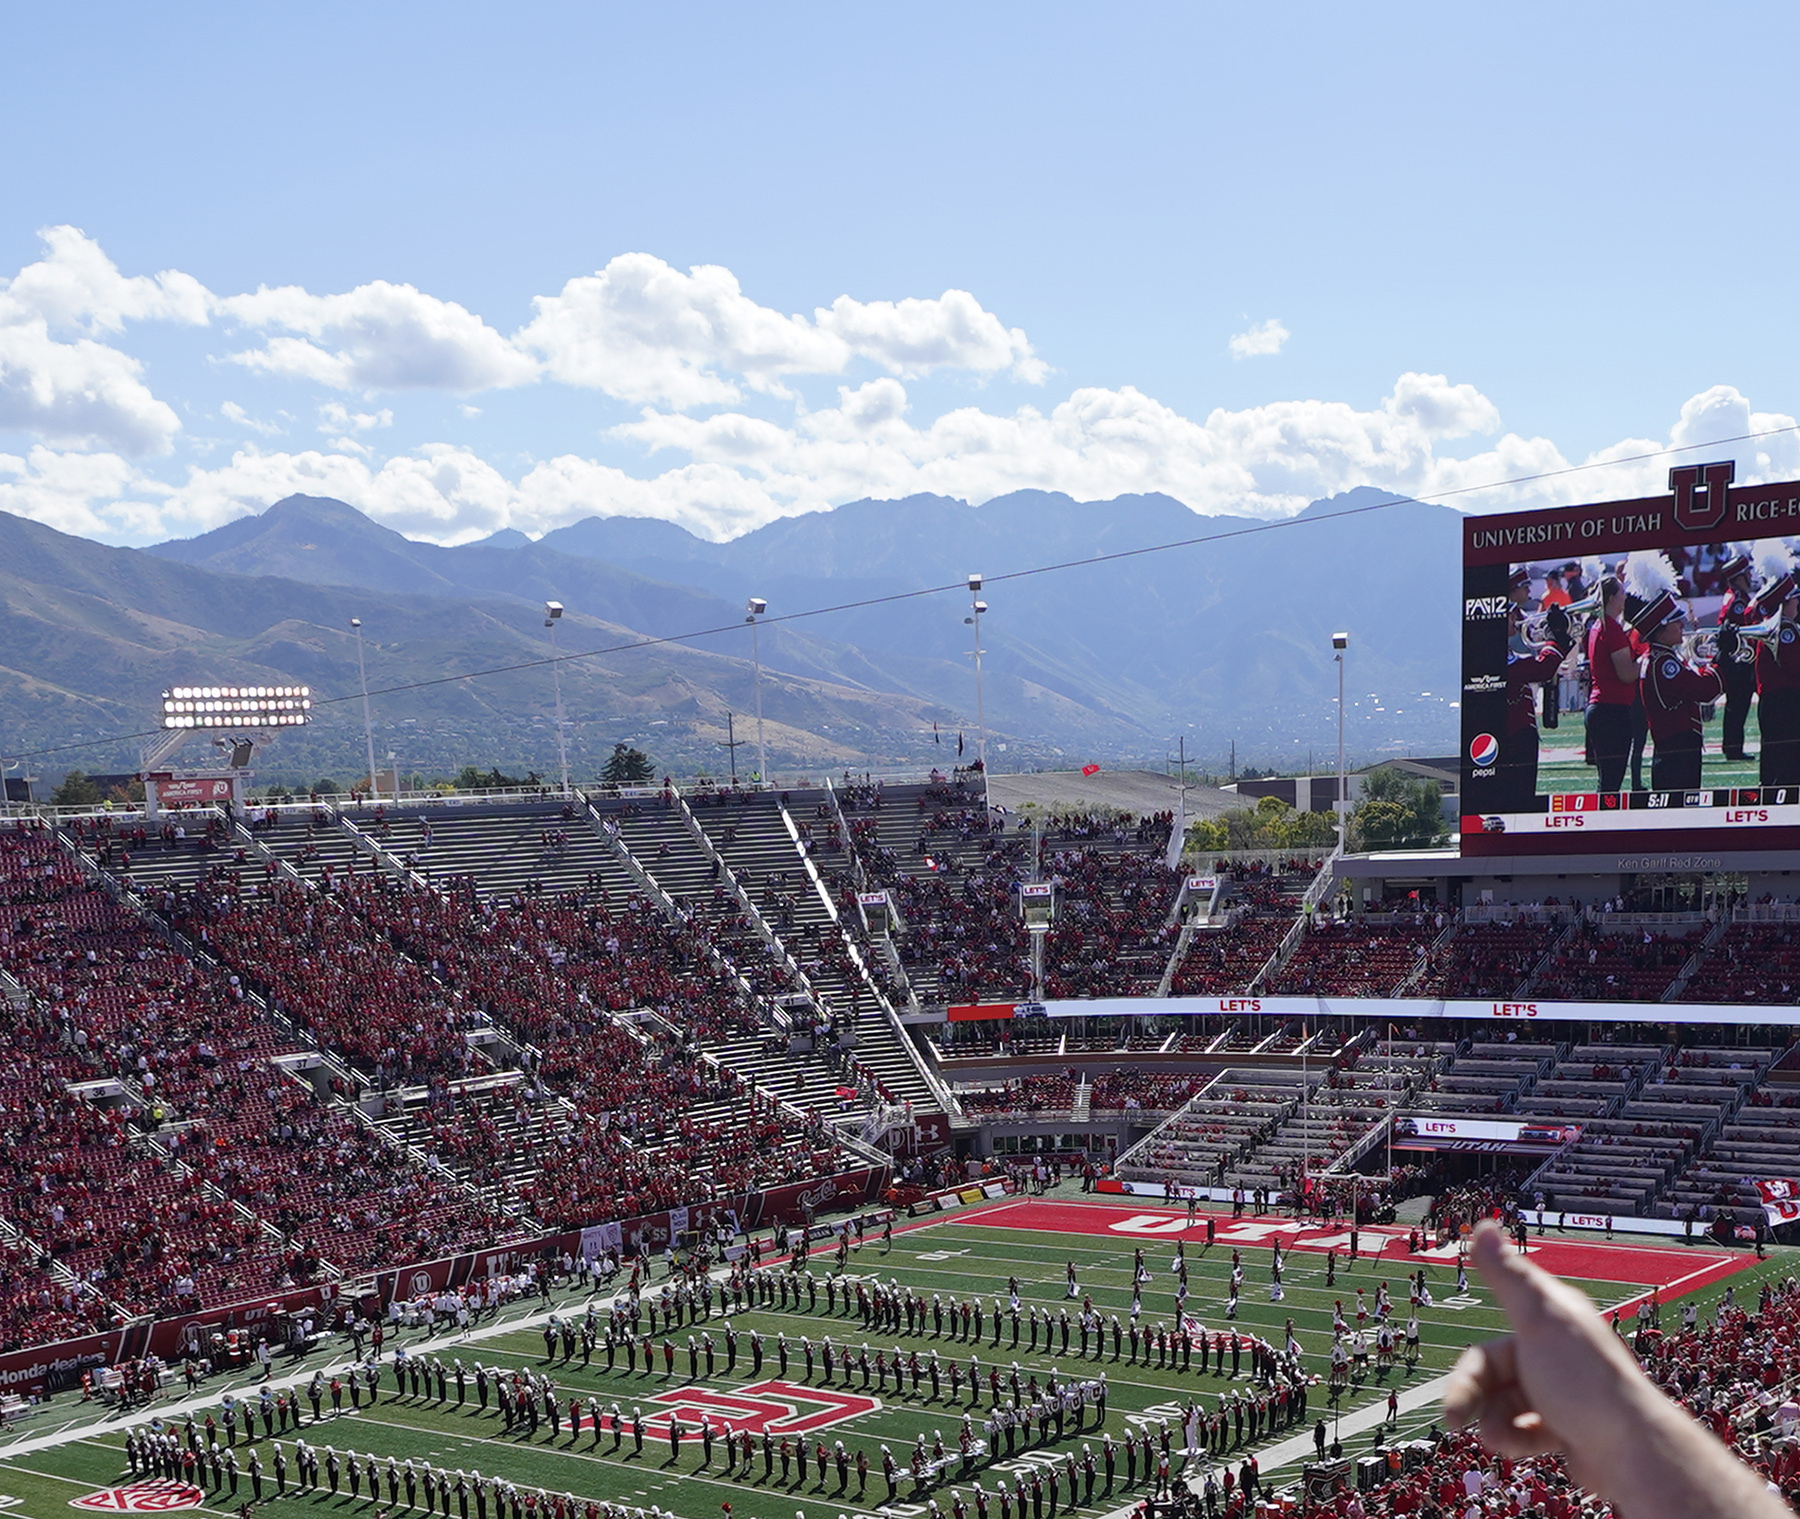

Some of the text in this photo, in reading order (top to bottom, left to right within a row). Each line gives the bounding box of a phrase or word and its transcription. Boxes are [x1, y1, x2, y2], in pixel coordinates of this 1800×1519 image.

[1669, 460, 1735, 530] U
[1472, 513, 1662, 549] UNIVERSITY OF UTAH
[1464, 680, 1507, 691] AMERICA FIRST
[1472, 767, 1496, 779] pepsi
[1648, 794, 1670, 807] 5:11
[1685, 795, 1699, 804] QTR
[1776, 789, 1787, 804] 0
[1575, 796, 1584, 810] 0
[1545, 816, 1584, 828] LET'S
[1726, 810, 1768, 823] LET'S
[1618, 857, 1721, 869] Ken Garff Red Zone
[1024, 886, 1048, 894] LET'S
[860, 894, 883, 902] LET'S
[784, 998, 794, 1006] 41
[1220, 1000, 1261, 1012] LET'S
[1493, 1004, 1538, 1017] LET'S
[296, 1060, 308, 1068] 37
[93, 1087, 106, 1098] 36
[1425, 1122, 1456, 1133] LET'S
[1450, 1140, 1507, 1152] UTAH
[1572, 1216, 1604, 1227] LET'S
[50, 1352, 106, 1371] dealers
